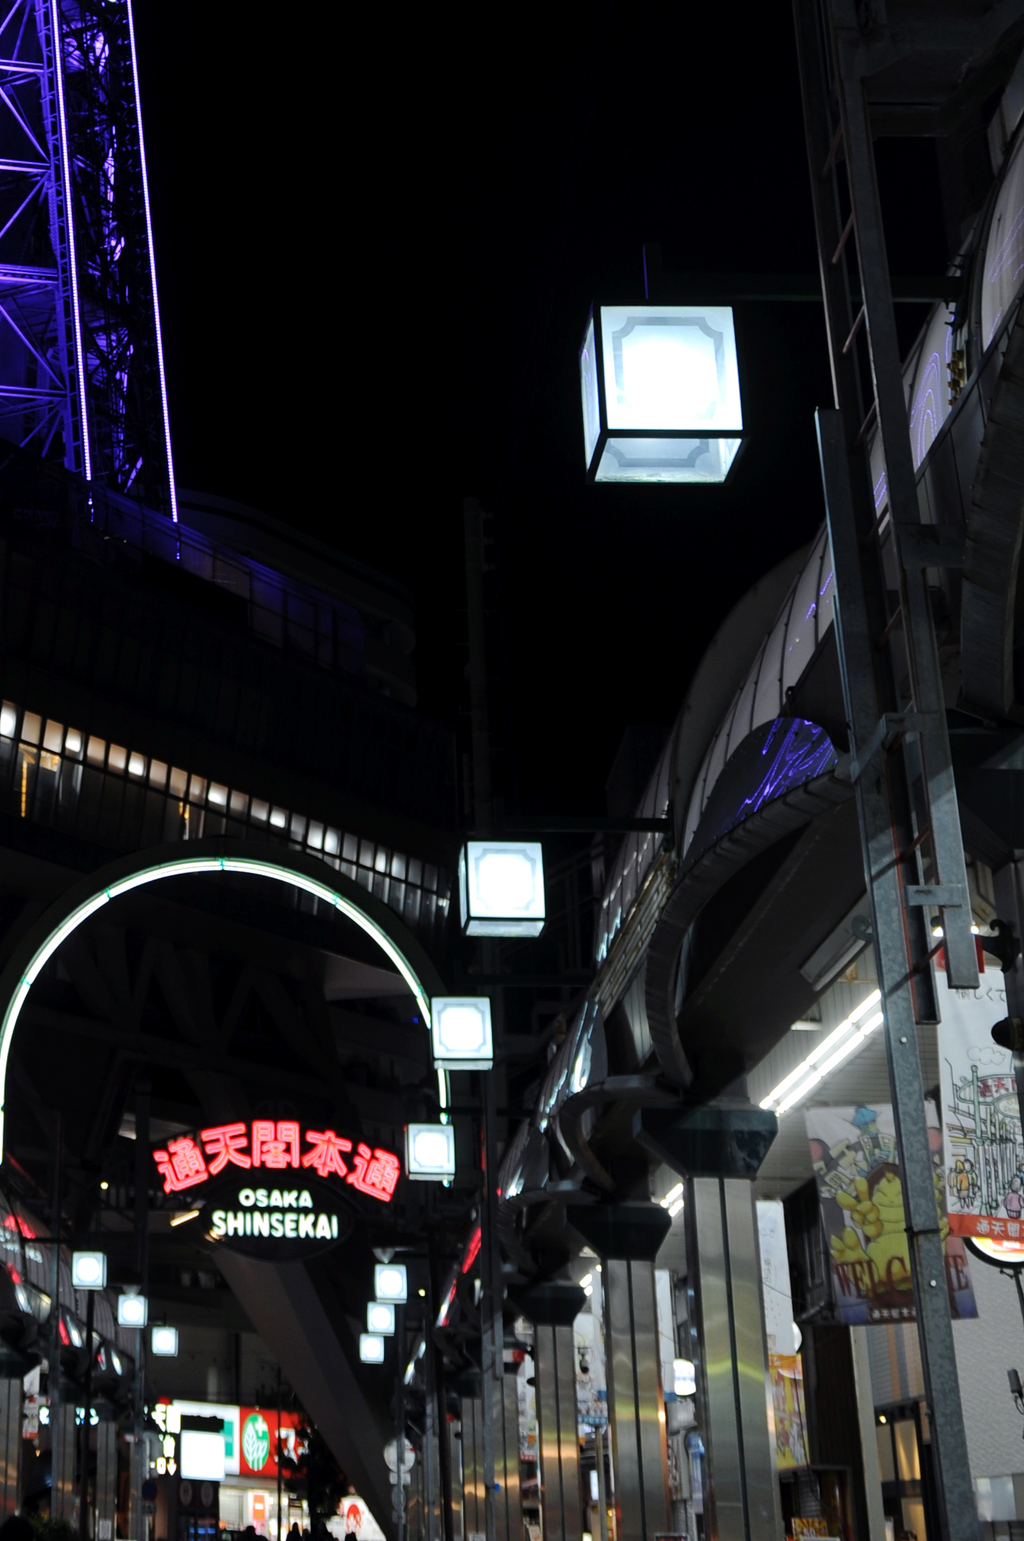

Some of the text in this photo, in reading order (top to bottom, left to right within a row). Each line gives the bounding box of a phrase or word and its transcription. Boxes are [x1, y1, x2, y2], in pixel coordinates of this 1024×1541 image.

[153, 1119, 401, 1203] 通天閣本通
[238, 1188, 314, 1209] OSAKA
[211, 1210, 339, 1240] SHINSEKAI
[977, 1219, 1024, 1238] 通天閣
